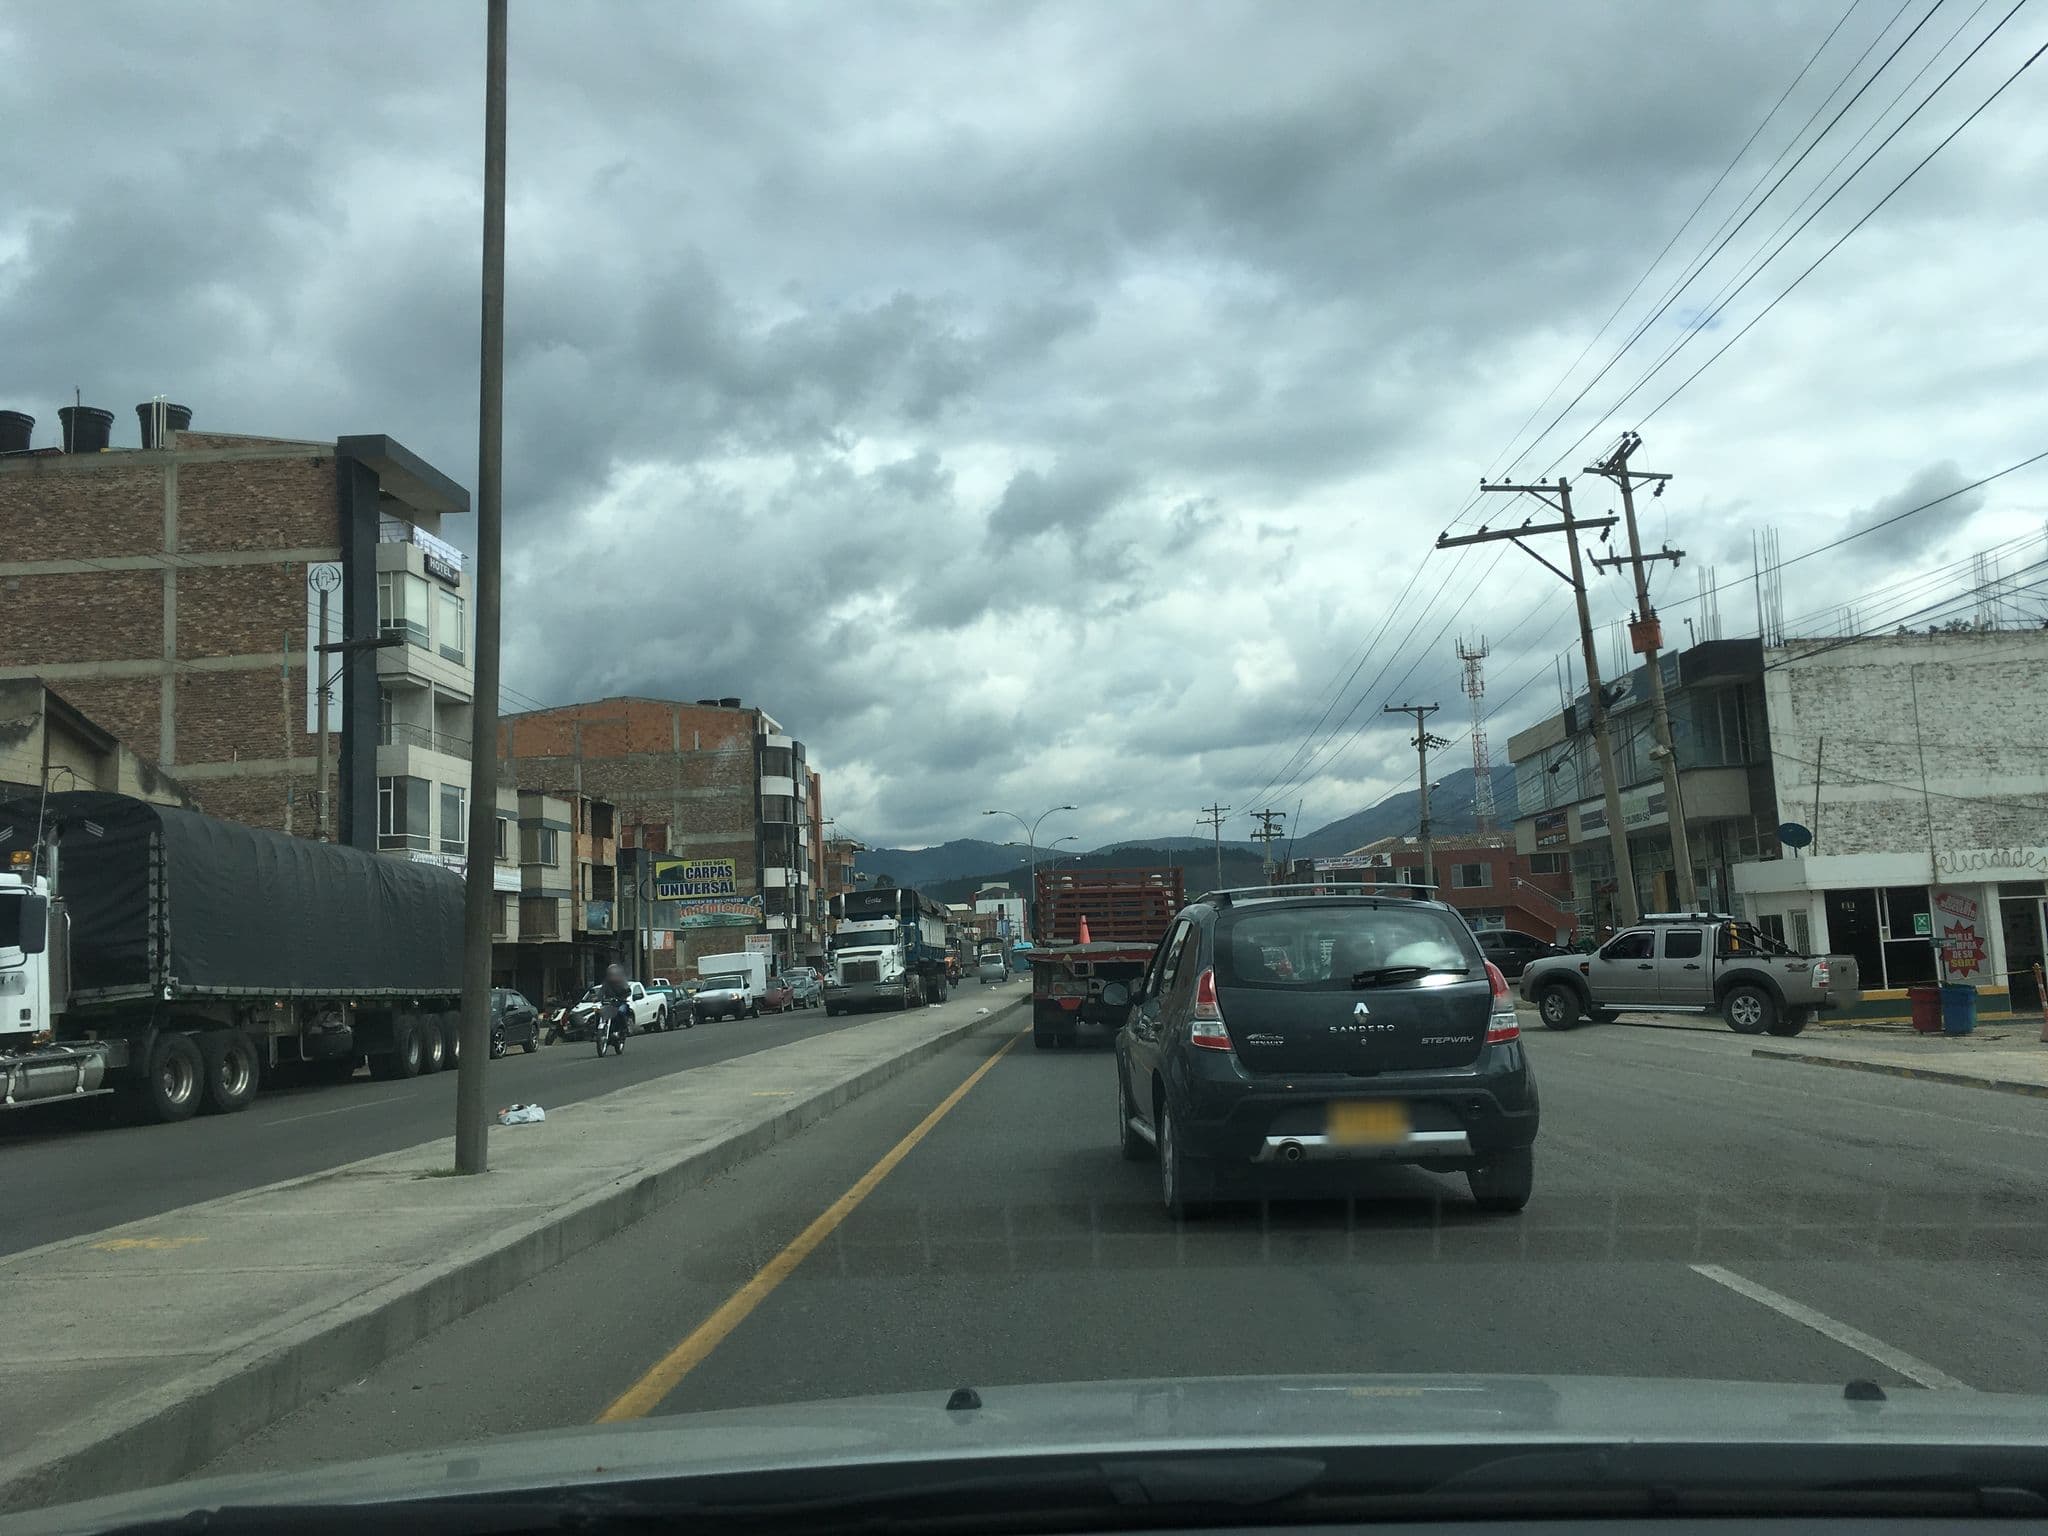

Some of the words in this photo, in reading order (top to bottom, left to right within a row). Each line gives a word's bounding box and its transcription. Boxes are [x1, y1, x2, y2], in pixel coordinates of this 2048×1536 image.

[430, 557, 452, 577] HOTEL
[685, 866, 732, 879] CARPAS
[660, 881, 736, 896] UNIVERSAL
[1328, 1025, 1395, 1033] SANDERO
[1421, 1036, 1474, 1044] STEPWAY
